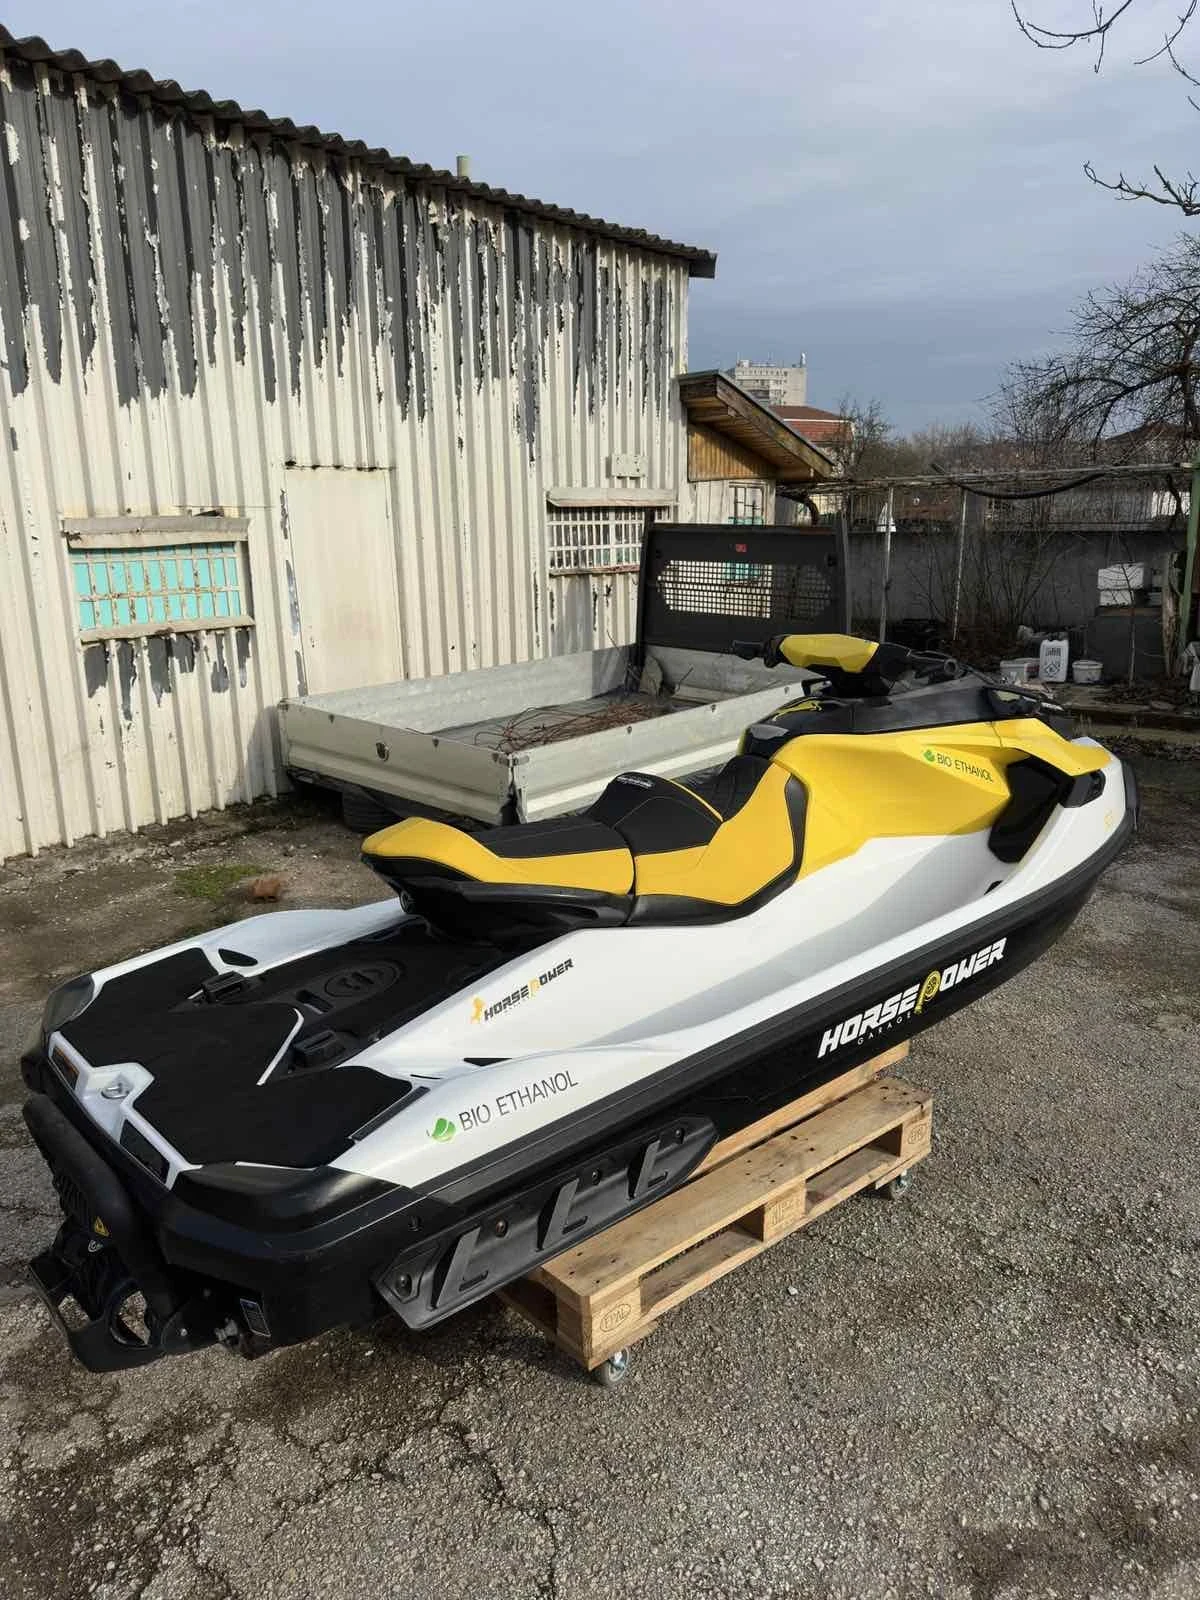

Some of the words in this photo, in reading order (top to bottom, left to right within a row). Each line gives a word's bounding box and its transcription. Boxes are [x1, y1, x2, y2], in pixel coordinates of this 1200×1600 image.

[937, 753, 952, 767] BIO
[954, 760, 994, 783] ETHANOL
[817, 937, 1007, 1058] HORSEPOWER
[857, 1012, 911, 1045] GARAGE
[458, 1103, 491, 1132] BIO
[495, 1070, 579, 1117] ETHANOL
